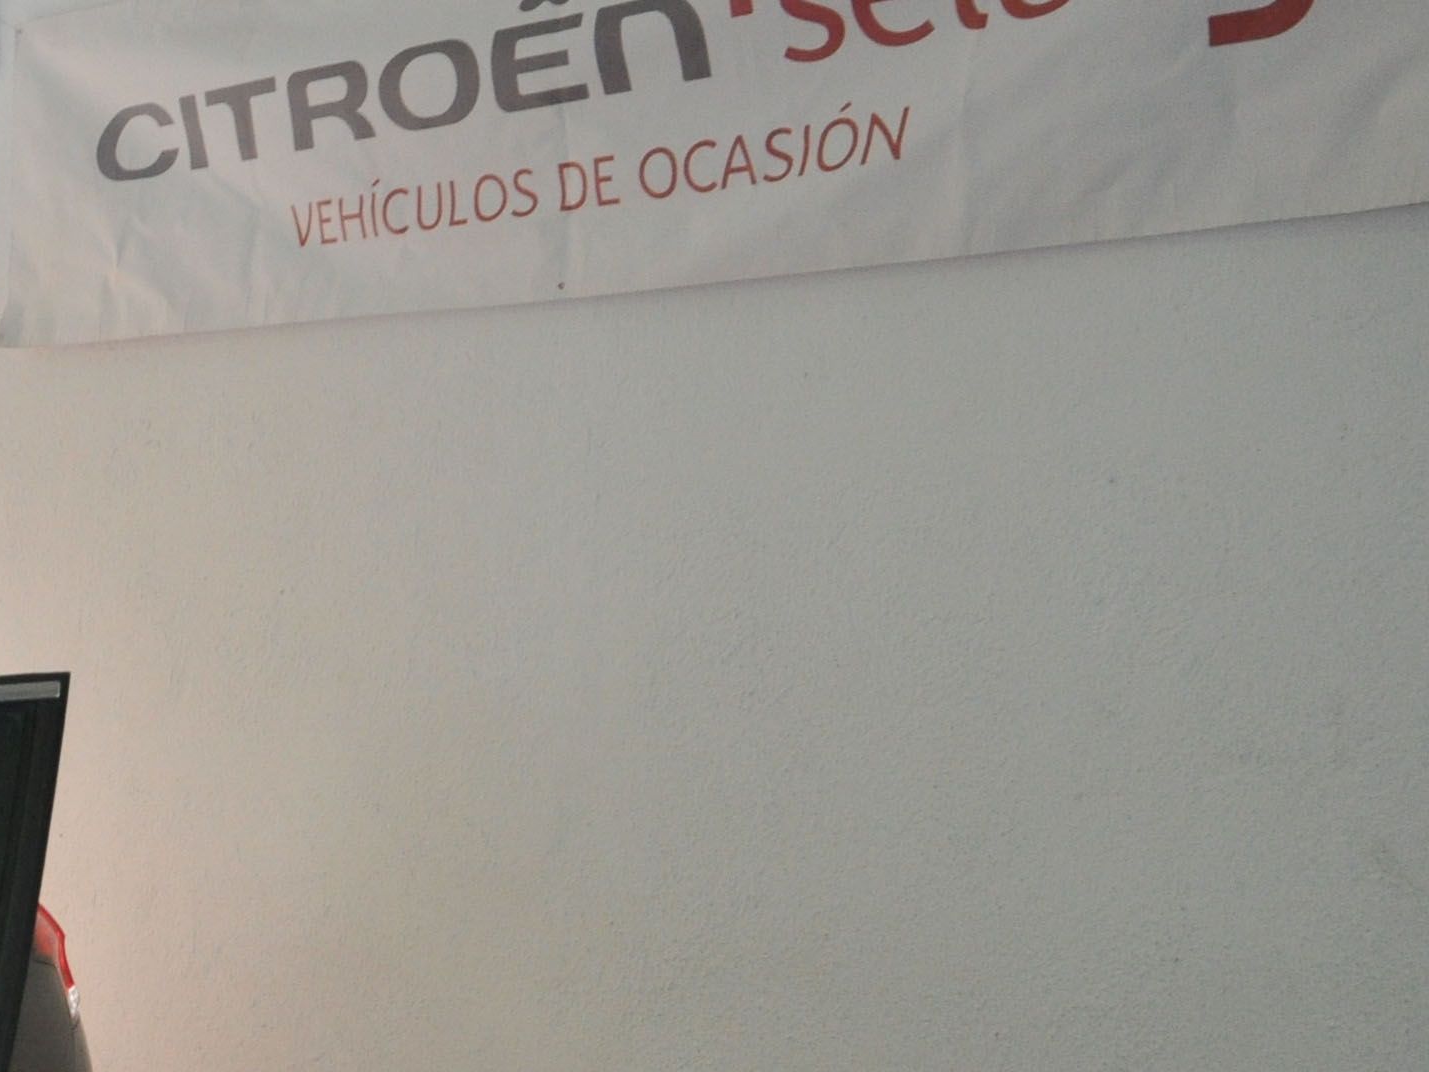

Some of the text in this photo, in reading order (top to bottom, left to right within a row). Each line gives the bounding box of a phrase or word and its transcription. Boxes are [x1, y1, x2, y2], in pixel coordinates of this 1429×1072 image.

[290, 102, 910, 247] VEHÍCULOS DE OCASIÓN
